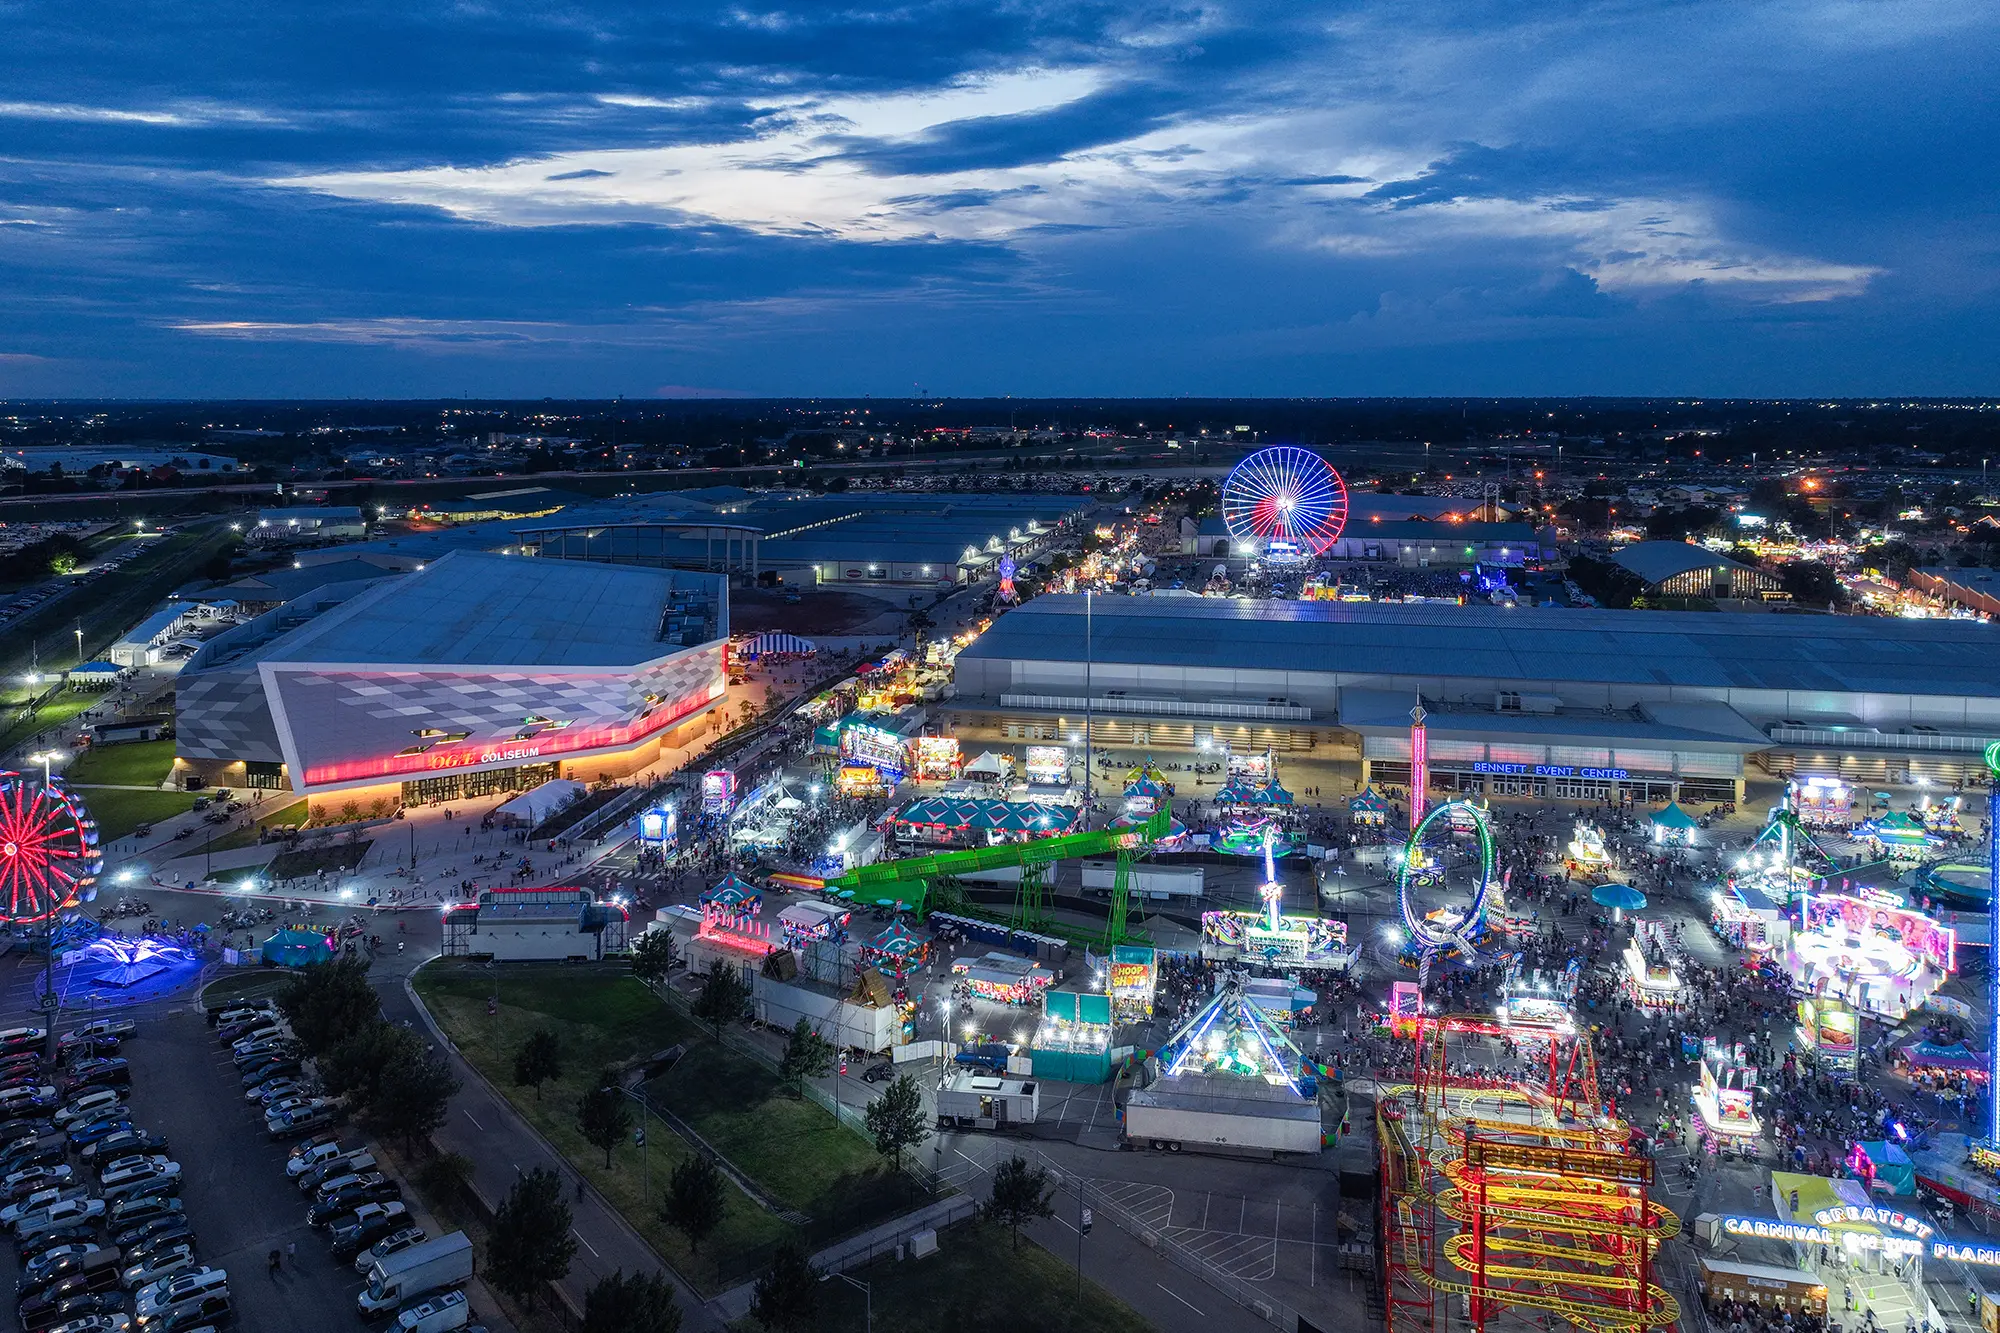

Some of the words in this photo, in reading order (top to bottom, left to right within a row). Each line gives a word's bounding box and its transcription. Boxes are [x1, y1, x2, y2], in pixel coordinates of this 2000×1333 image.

[481, 747, 539, 763] COLISEUM
[1474, 762, 1527, 774] BENNETT
[1535, 765, 1574, 777] EVENT
[1580, 768, 1628, 779] CENTER
[1118, 966, 1144, 976] HOOP
[1113, 976, 1147, 987] SHOTS
[43, 998, 57, 1007] G1
[1815, 1206, 1933, 1238] GREATEST
[1724, 1218, 1834, 1244] CARNIVAL
